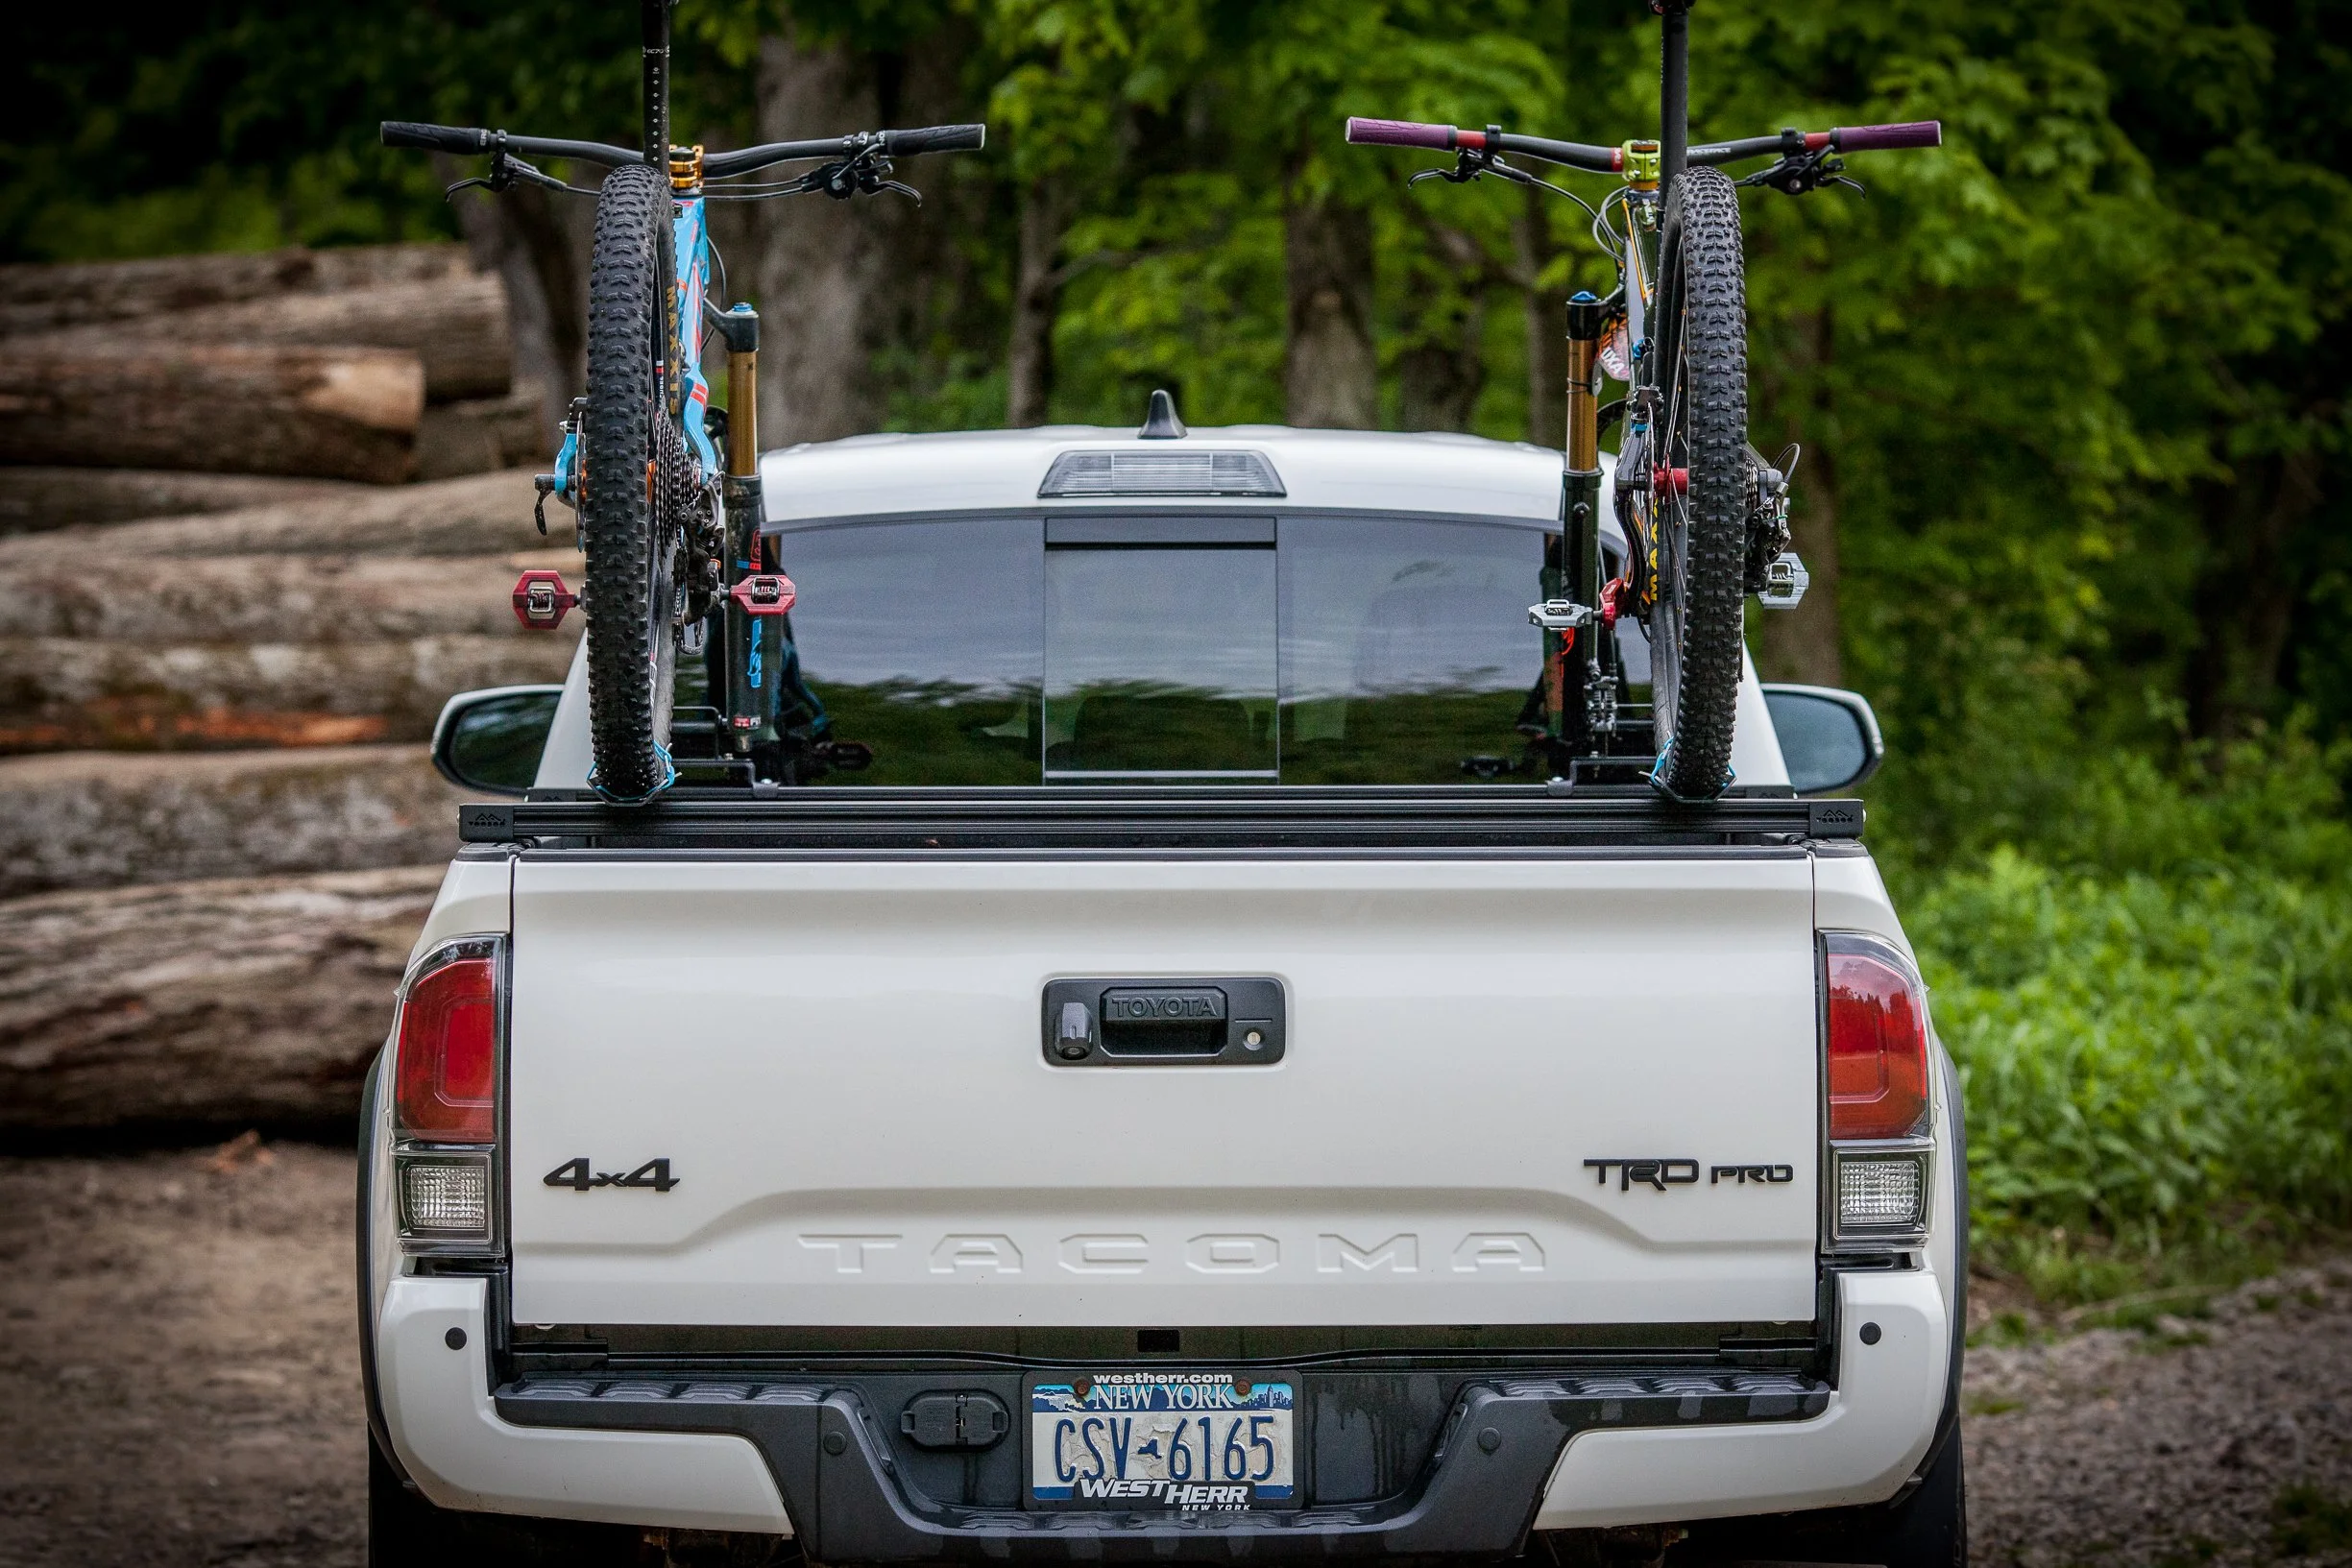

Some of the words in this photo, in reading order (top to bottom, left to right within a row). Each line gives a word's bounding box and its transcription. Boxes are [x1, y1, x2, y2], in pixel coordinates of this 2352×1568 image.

[667, 285, 679, 415] MAXXIS
[1111, 997, 1219, 1018] TOYOTA
[543, 1157, 681, 1192] 4x4
[1584, 1158, 1700, 1191] TRD
[1710, 1164, 1794, 1184] PRO
[796, 1232, 1546, 1274] TACOMA
[1092, 1372, 1233, 1385] westherr.com
[1093, 1385, 1156, 1410] NEW
[1161, 1385, 1234, 1410] YORK
[1055, 1415, 1132, 1482] CSV
[1168, 1415, 1275, 1482] 6165
